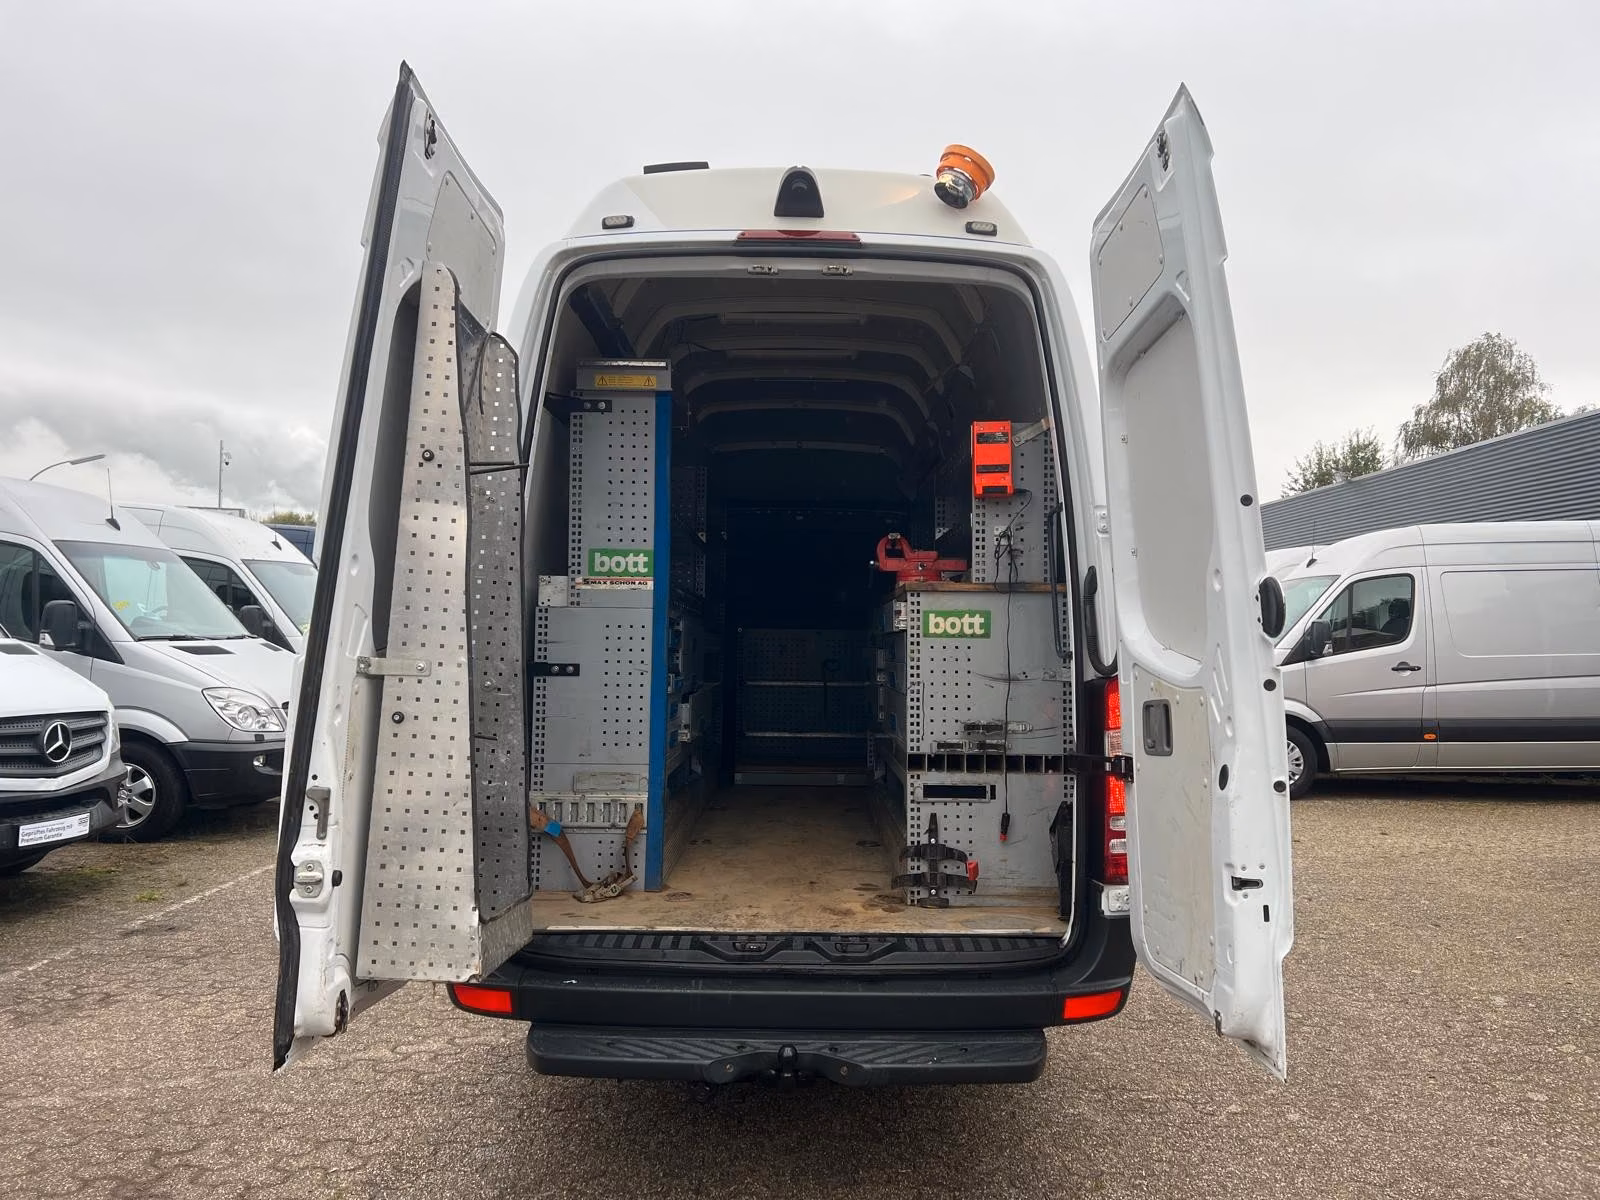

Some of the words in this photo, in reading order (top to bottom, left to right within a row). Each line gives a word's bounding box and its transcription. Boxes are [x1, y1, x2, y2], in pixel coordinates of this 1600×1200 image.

[594, 552, 648, 573] bott
[928, 613, 985, 635] bott
[21, 836, 43, 844] Premium
[44, 832, 63, 840] Garantie
